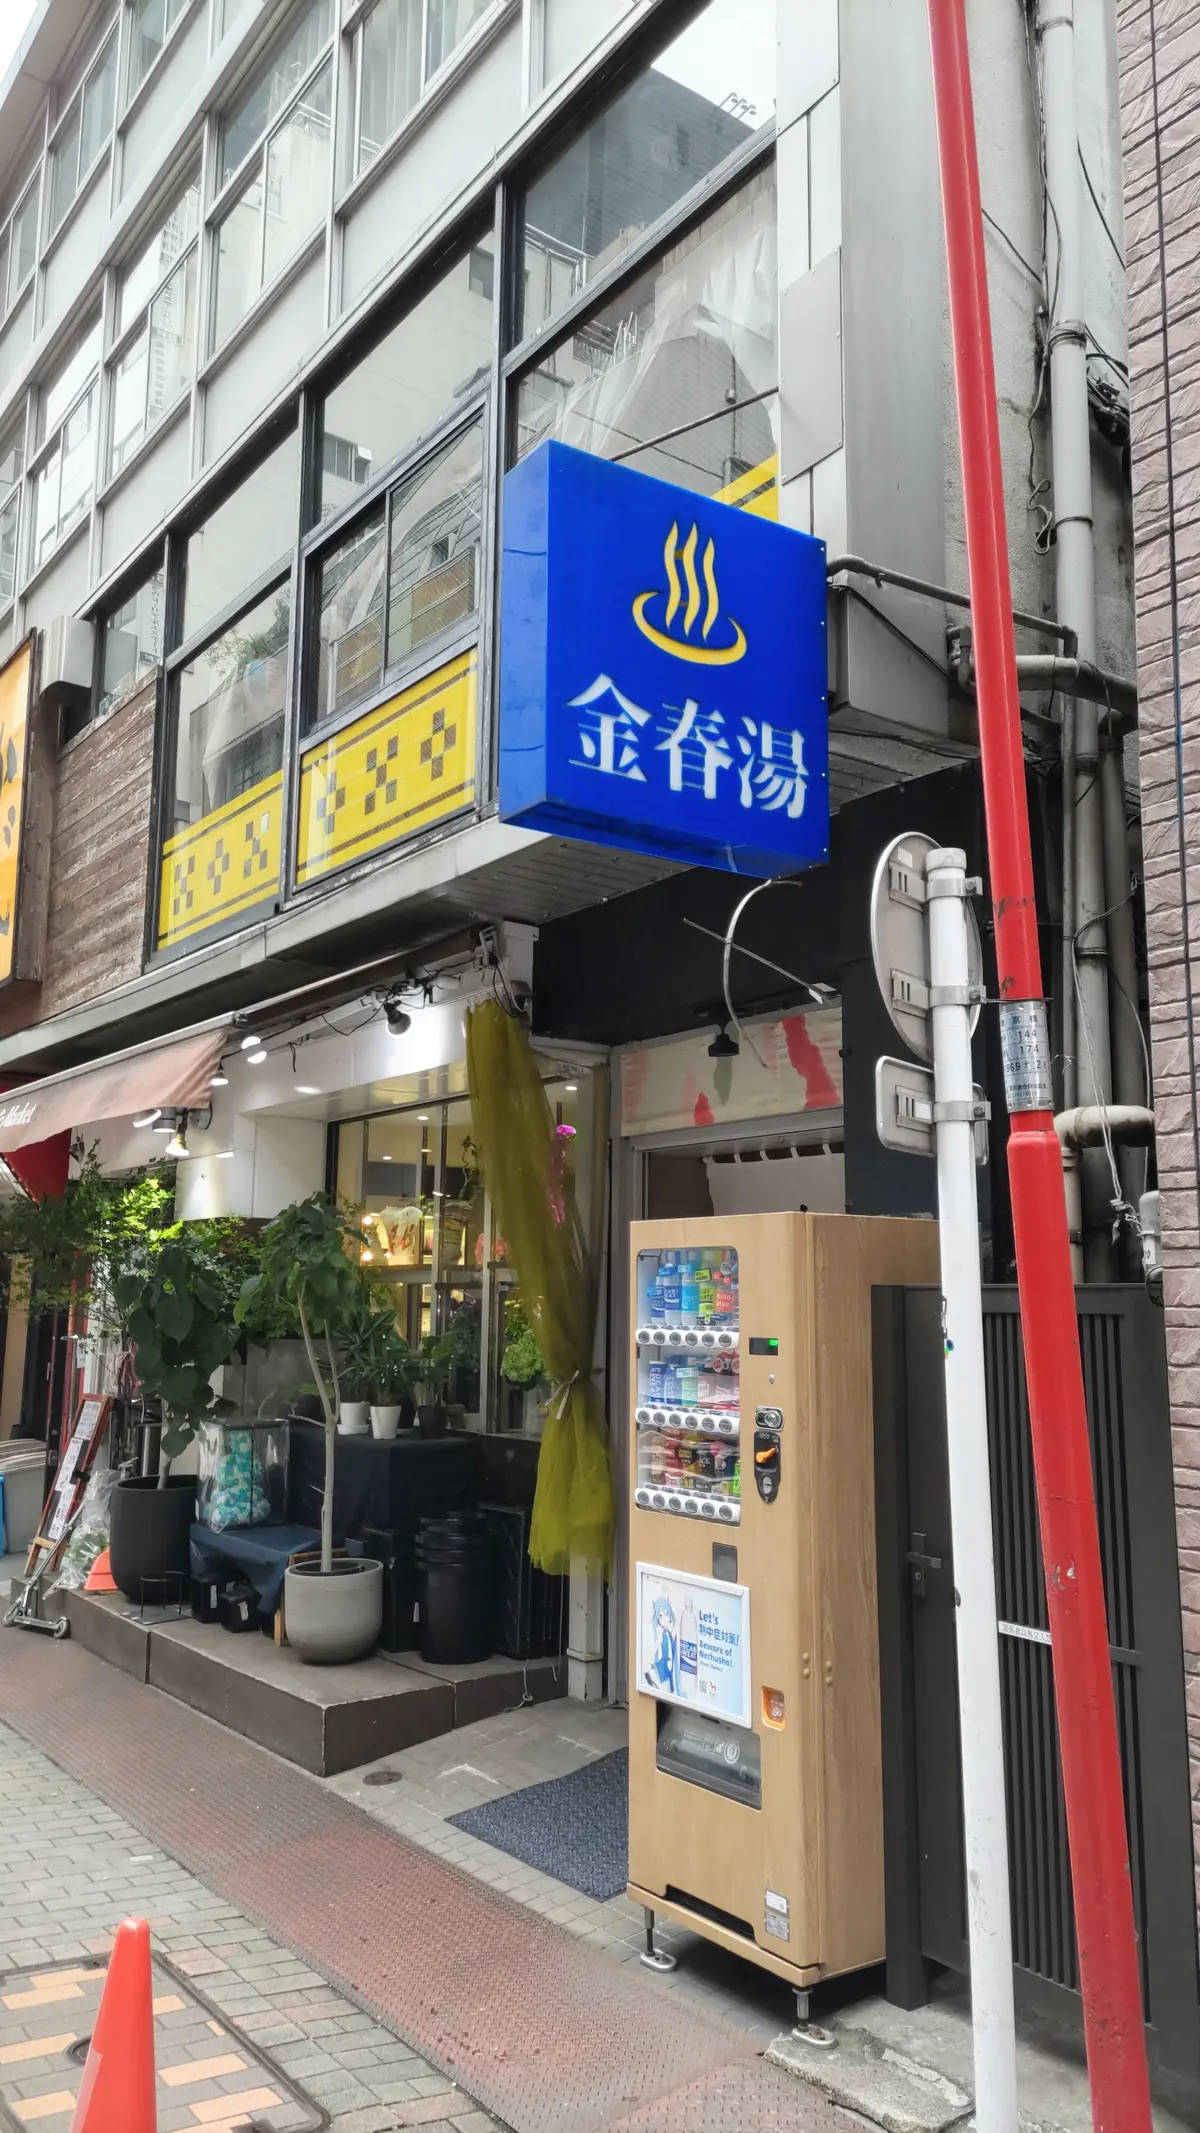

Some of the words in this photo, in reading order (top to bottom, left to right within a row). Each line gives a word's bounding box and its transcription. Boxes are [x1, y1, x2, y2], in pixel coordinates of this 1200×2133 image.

[566, 673, 809, 819] 金春湯
[699, 1610, 719, 1625] Let's
[699, 1640, 724, 1655] Beware
[724, 1648, 733, 1657] of
[699, 1650, 733, 1668] Nechusho!
